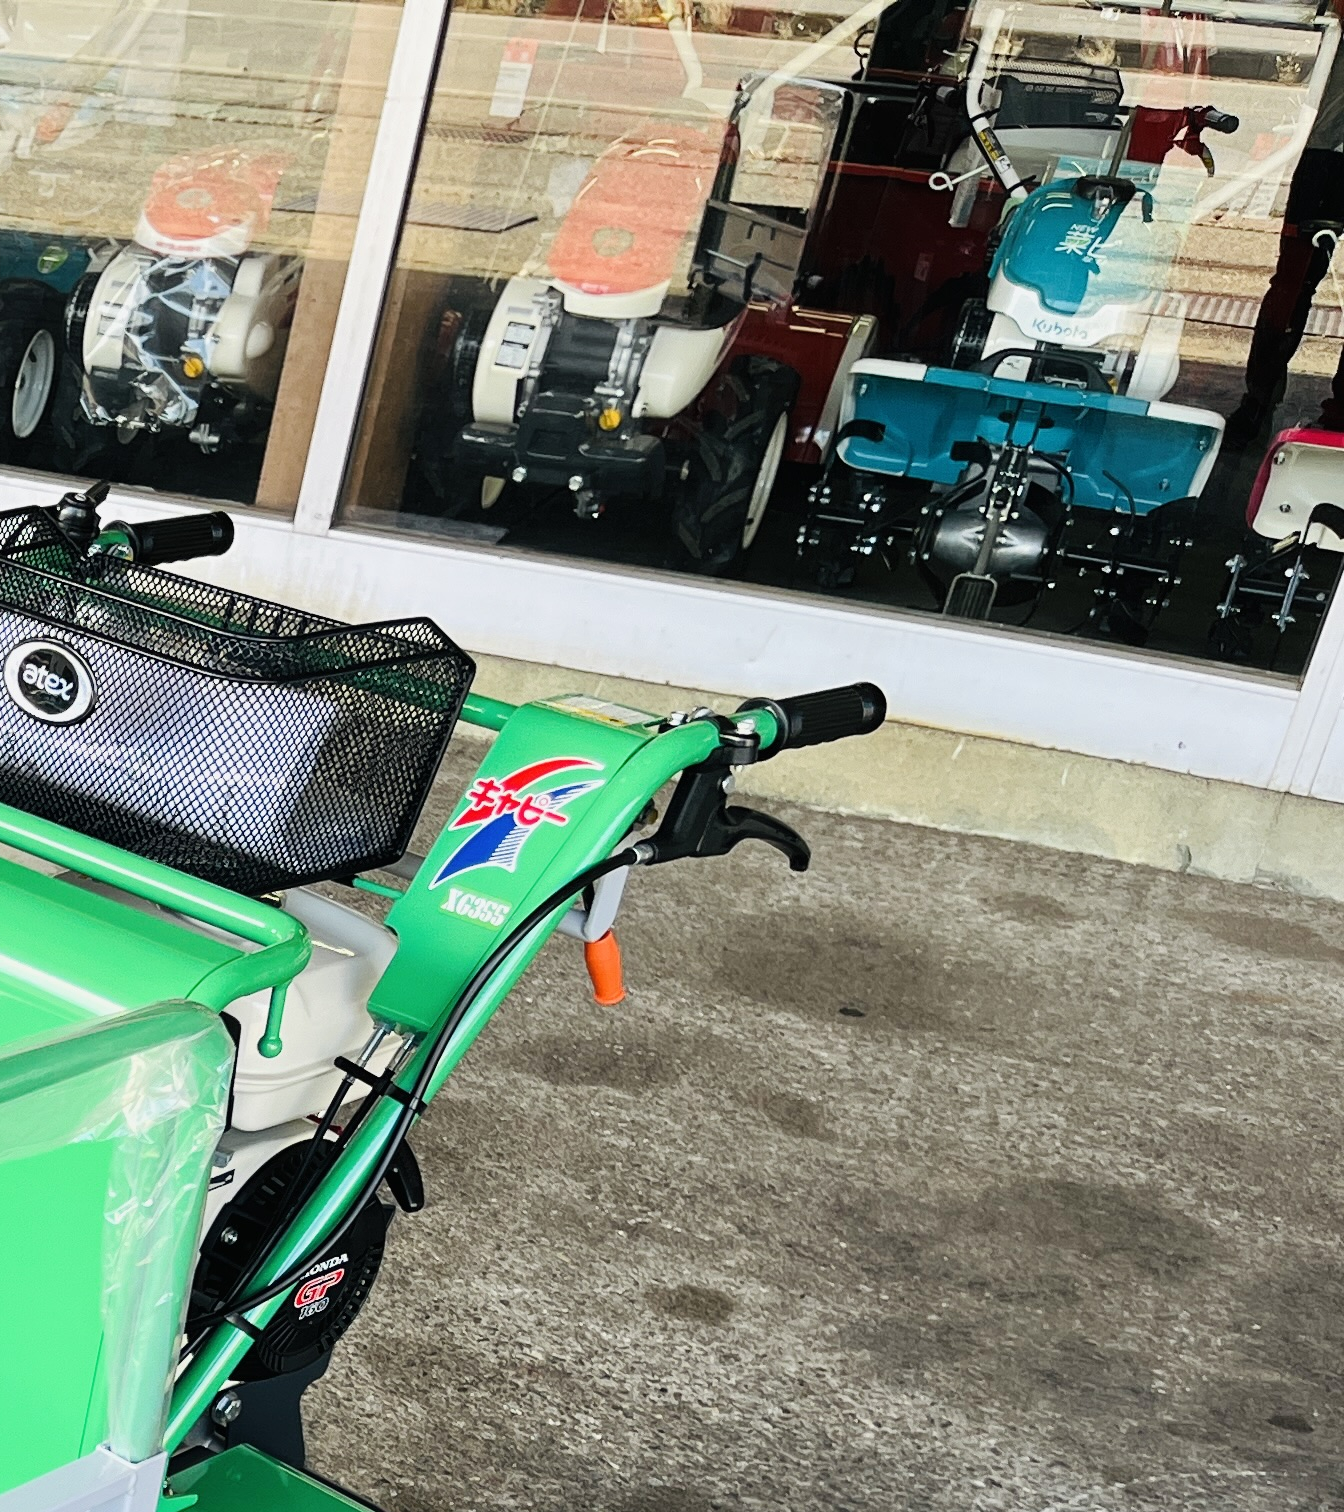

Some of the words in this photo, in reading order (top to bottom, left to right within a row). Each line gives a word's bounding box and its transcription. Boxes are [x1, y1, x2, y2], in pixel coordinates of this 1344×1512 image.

[1070, 223, 1100, 234] NEW
[1032, 317, 1089, 340] Kubota
[22, 663, 74, 701] atex
[467, 777, 569, 827] キャピー
[440, 887, 511, 927] XG355
[300, 1253, 349, 1280] ONDA
[294, 1268, 346, 1308] GP
